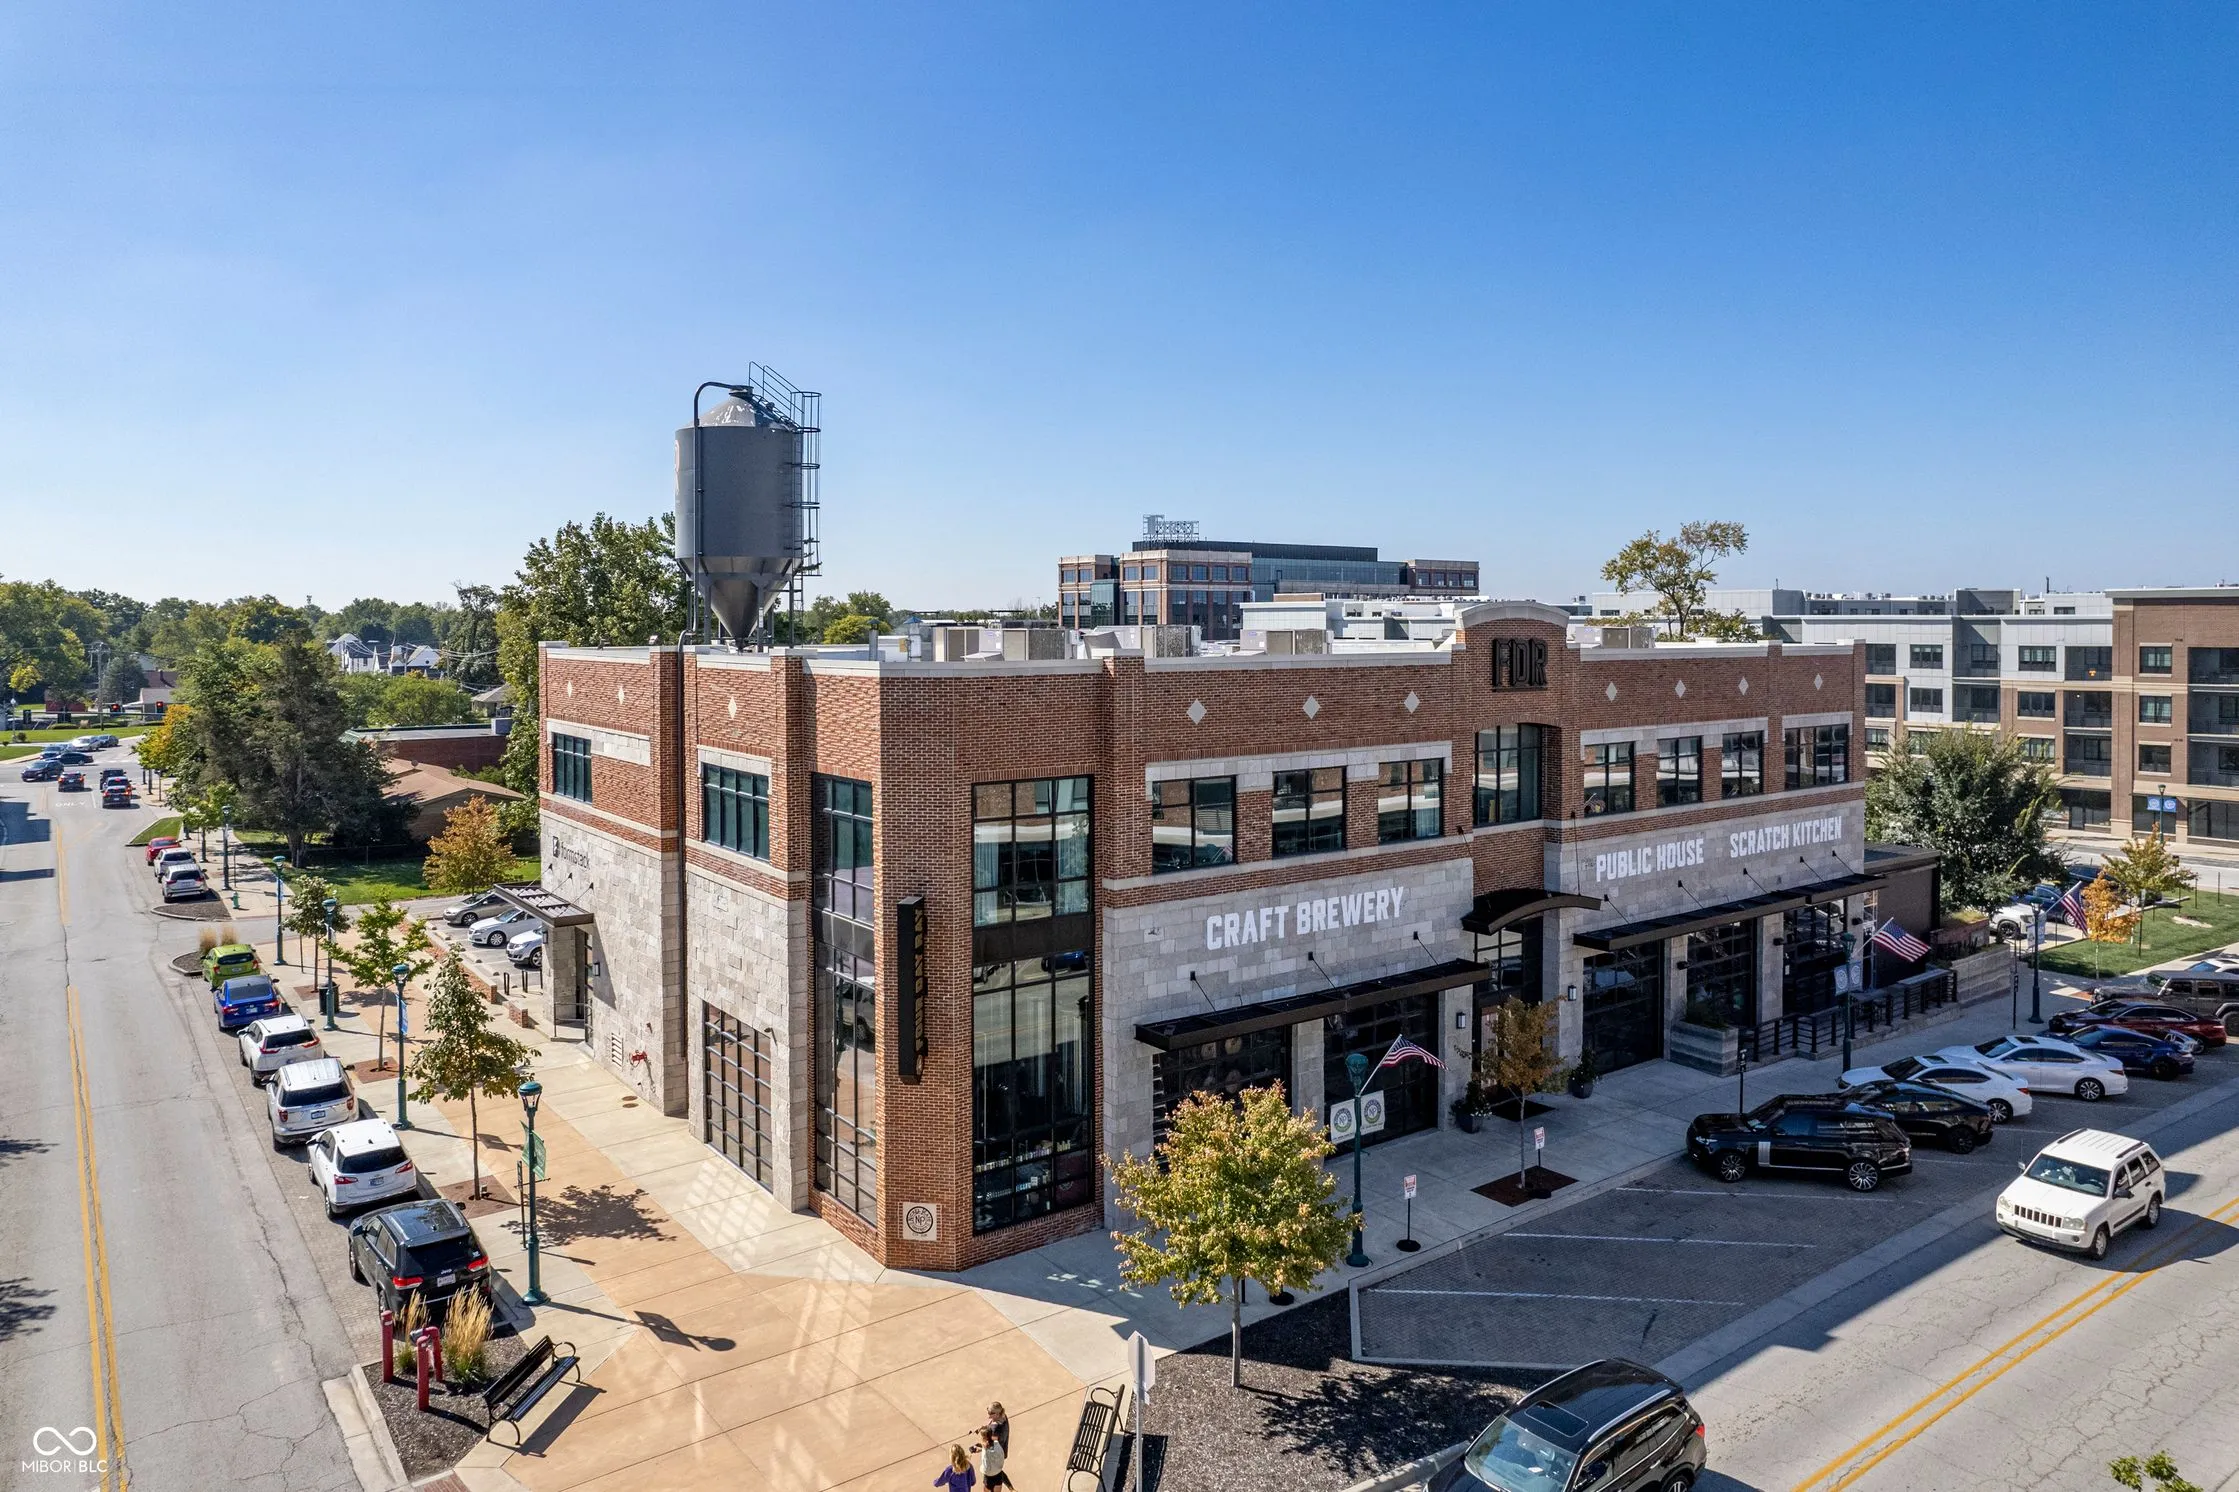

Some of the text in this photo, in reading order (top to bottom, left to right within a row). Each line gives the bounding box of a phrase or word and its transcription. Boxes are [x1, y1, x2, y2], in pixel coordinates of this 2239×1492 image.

[1492, 638, 1548, 687] FDR
[1729, 816, 1842, 859] SCRATCH KITCHEN
[1596, 838, 1704, 882] PUBLIC HOUSE
[914, 908, 924, 949] RAY
[1206, 887, 1404, 951] CRAFT BREWERY
[914, 953, 924, 995] DAY
